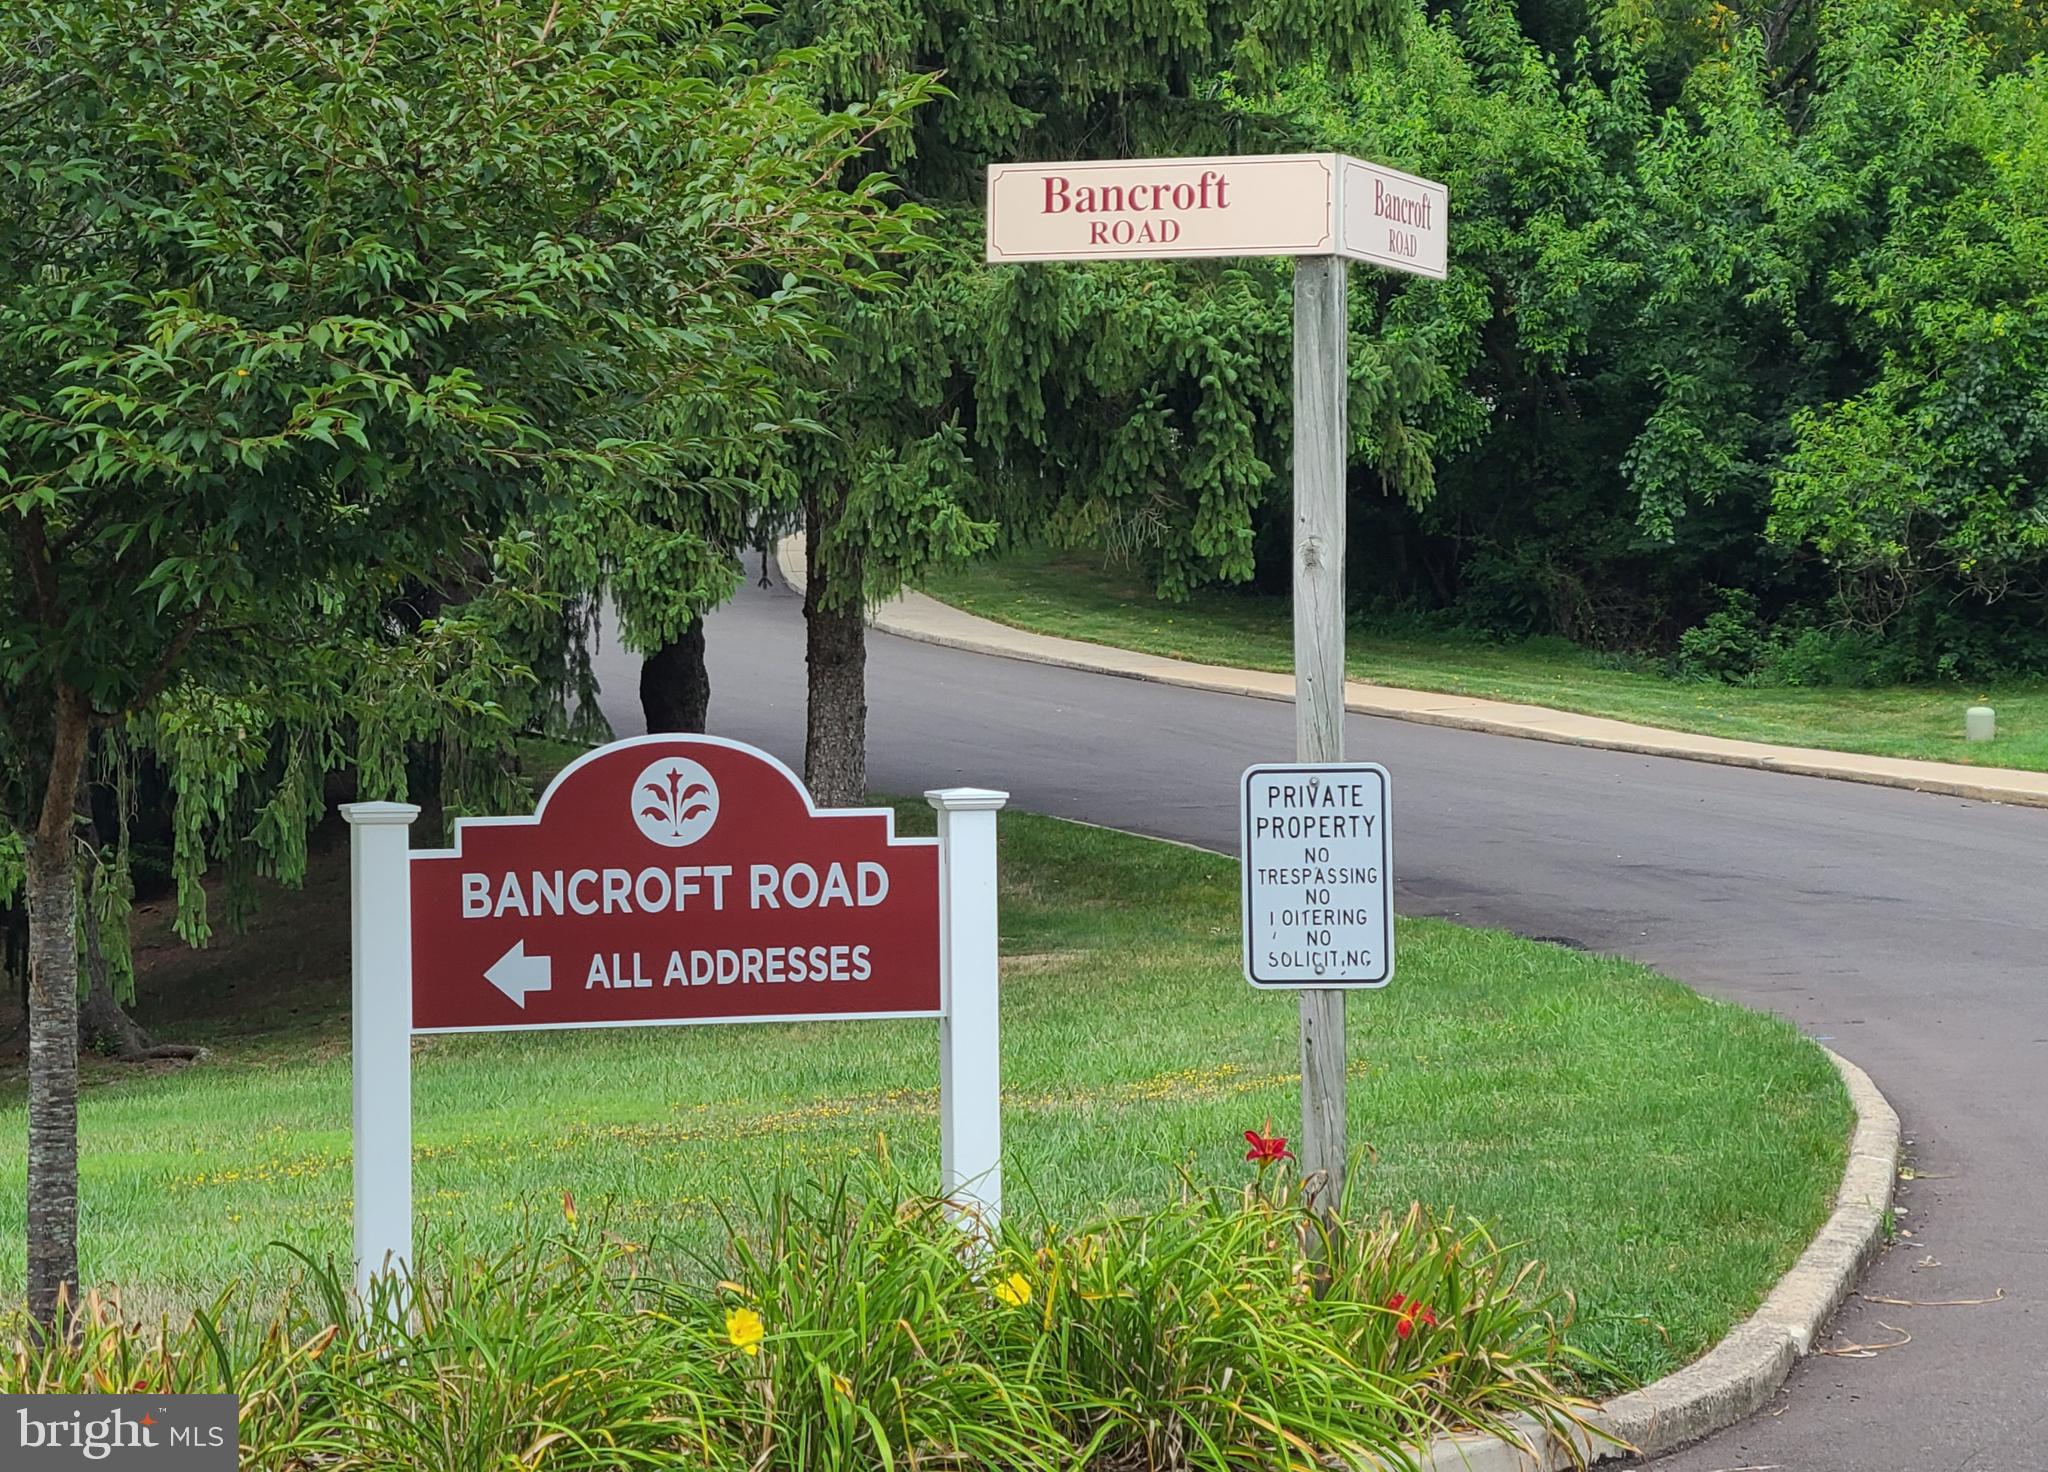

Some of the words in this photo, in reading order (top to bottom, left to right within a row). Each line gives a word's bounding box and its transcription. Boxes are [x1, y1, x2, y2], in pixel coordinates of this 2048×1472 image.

[1041, 171, 1230, 213] Bancroft
[1374, 178, 1432, 231] Bancroft
[1089, 219, 1181, 245] ROAD
[1388, 228, 1417, 258] ROAD
[1268, 785, 1363, 808] PRIVATE
[1257, 815, 1375, 839] PROPERTY
[1305, 848, 1329, 863] NO
[1258, 868, 1377, 885] TRESPASSING
[461, 866, 733, 918] BANCROFT
[750, 862, 889, 910] ROAD
[1306, 889, 1330, 905] NO
[1307, 930, 1331, 946] NO
[585, 952, 653, 990] ALL
[663, 944, 871, 986] ADDRESSES
